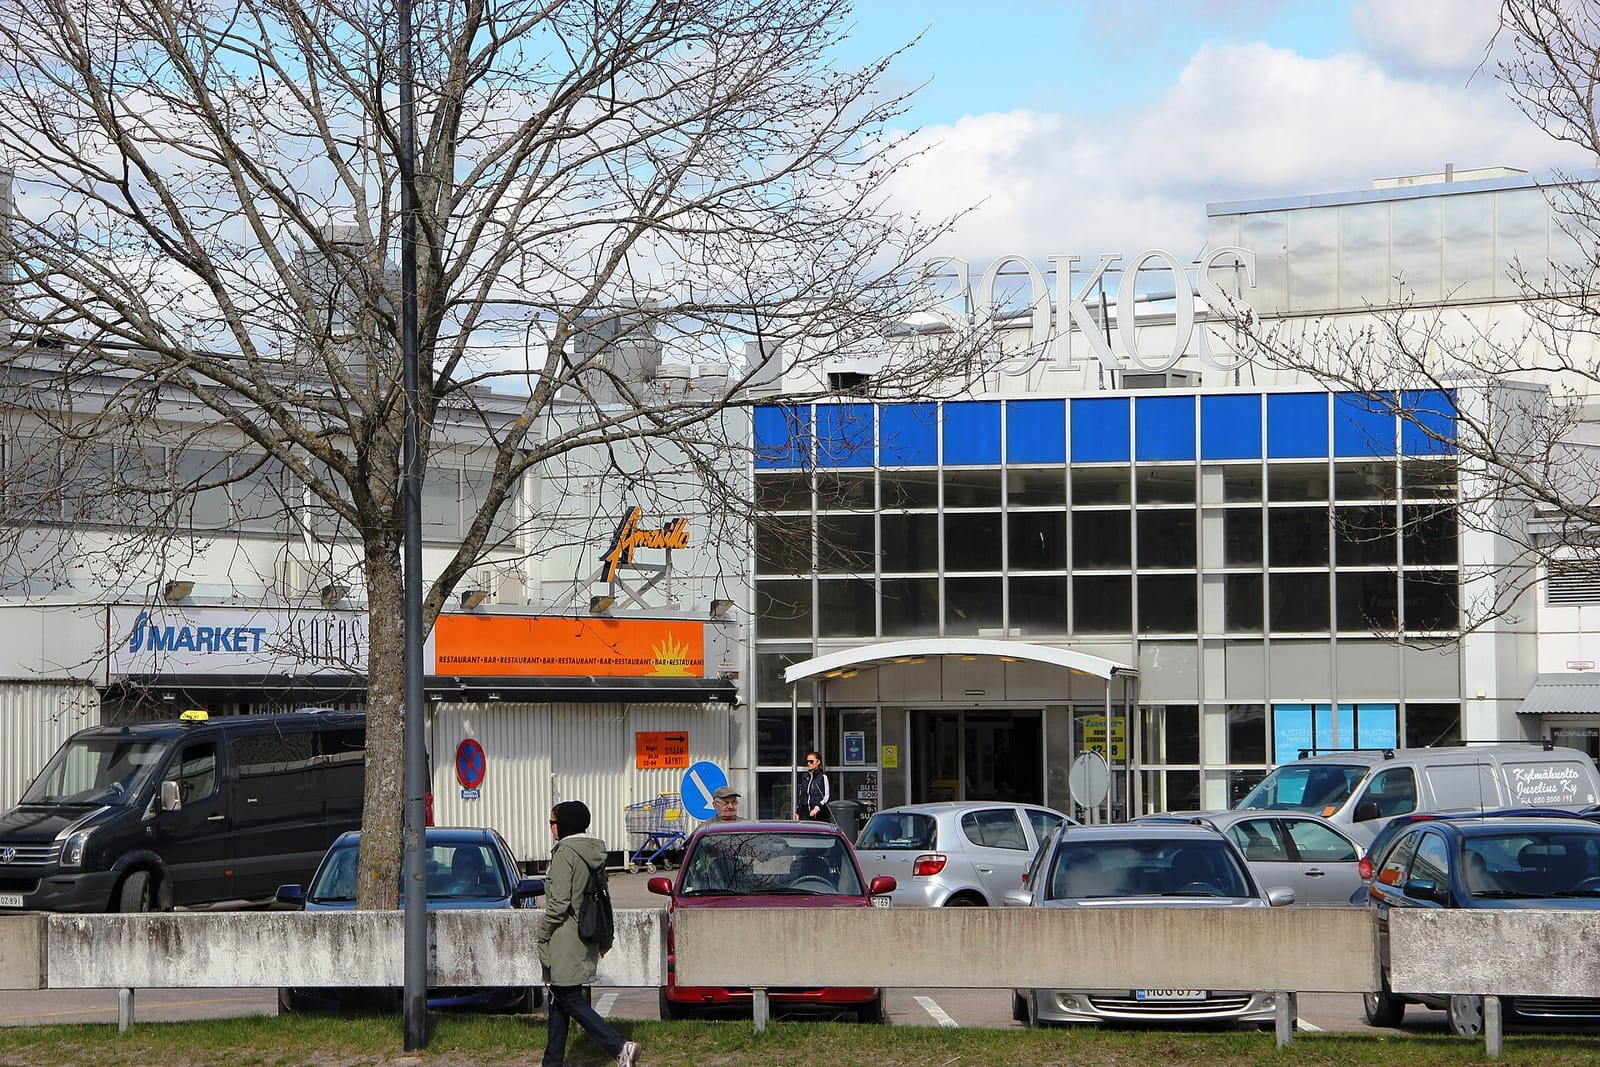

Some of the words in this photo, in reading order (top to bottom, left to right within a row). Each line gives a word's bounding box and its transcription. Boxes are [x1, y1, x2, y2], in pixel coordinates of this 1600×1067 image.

[920, 246, 1260, 378] SOKOS
[147, 626, 267, 652] MARKET
[298, 618, 361, 667] SOKOS
[1513, 767, 1579, 784] Kylmähuolto
[1517, 781, 1557, 799] Juselius
[1560, 779, 1578, 796] Ky
